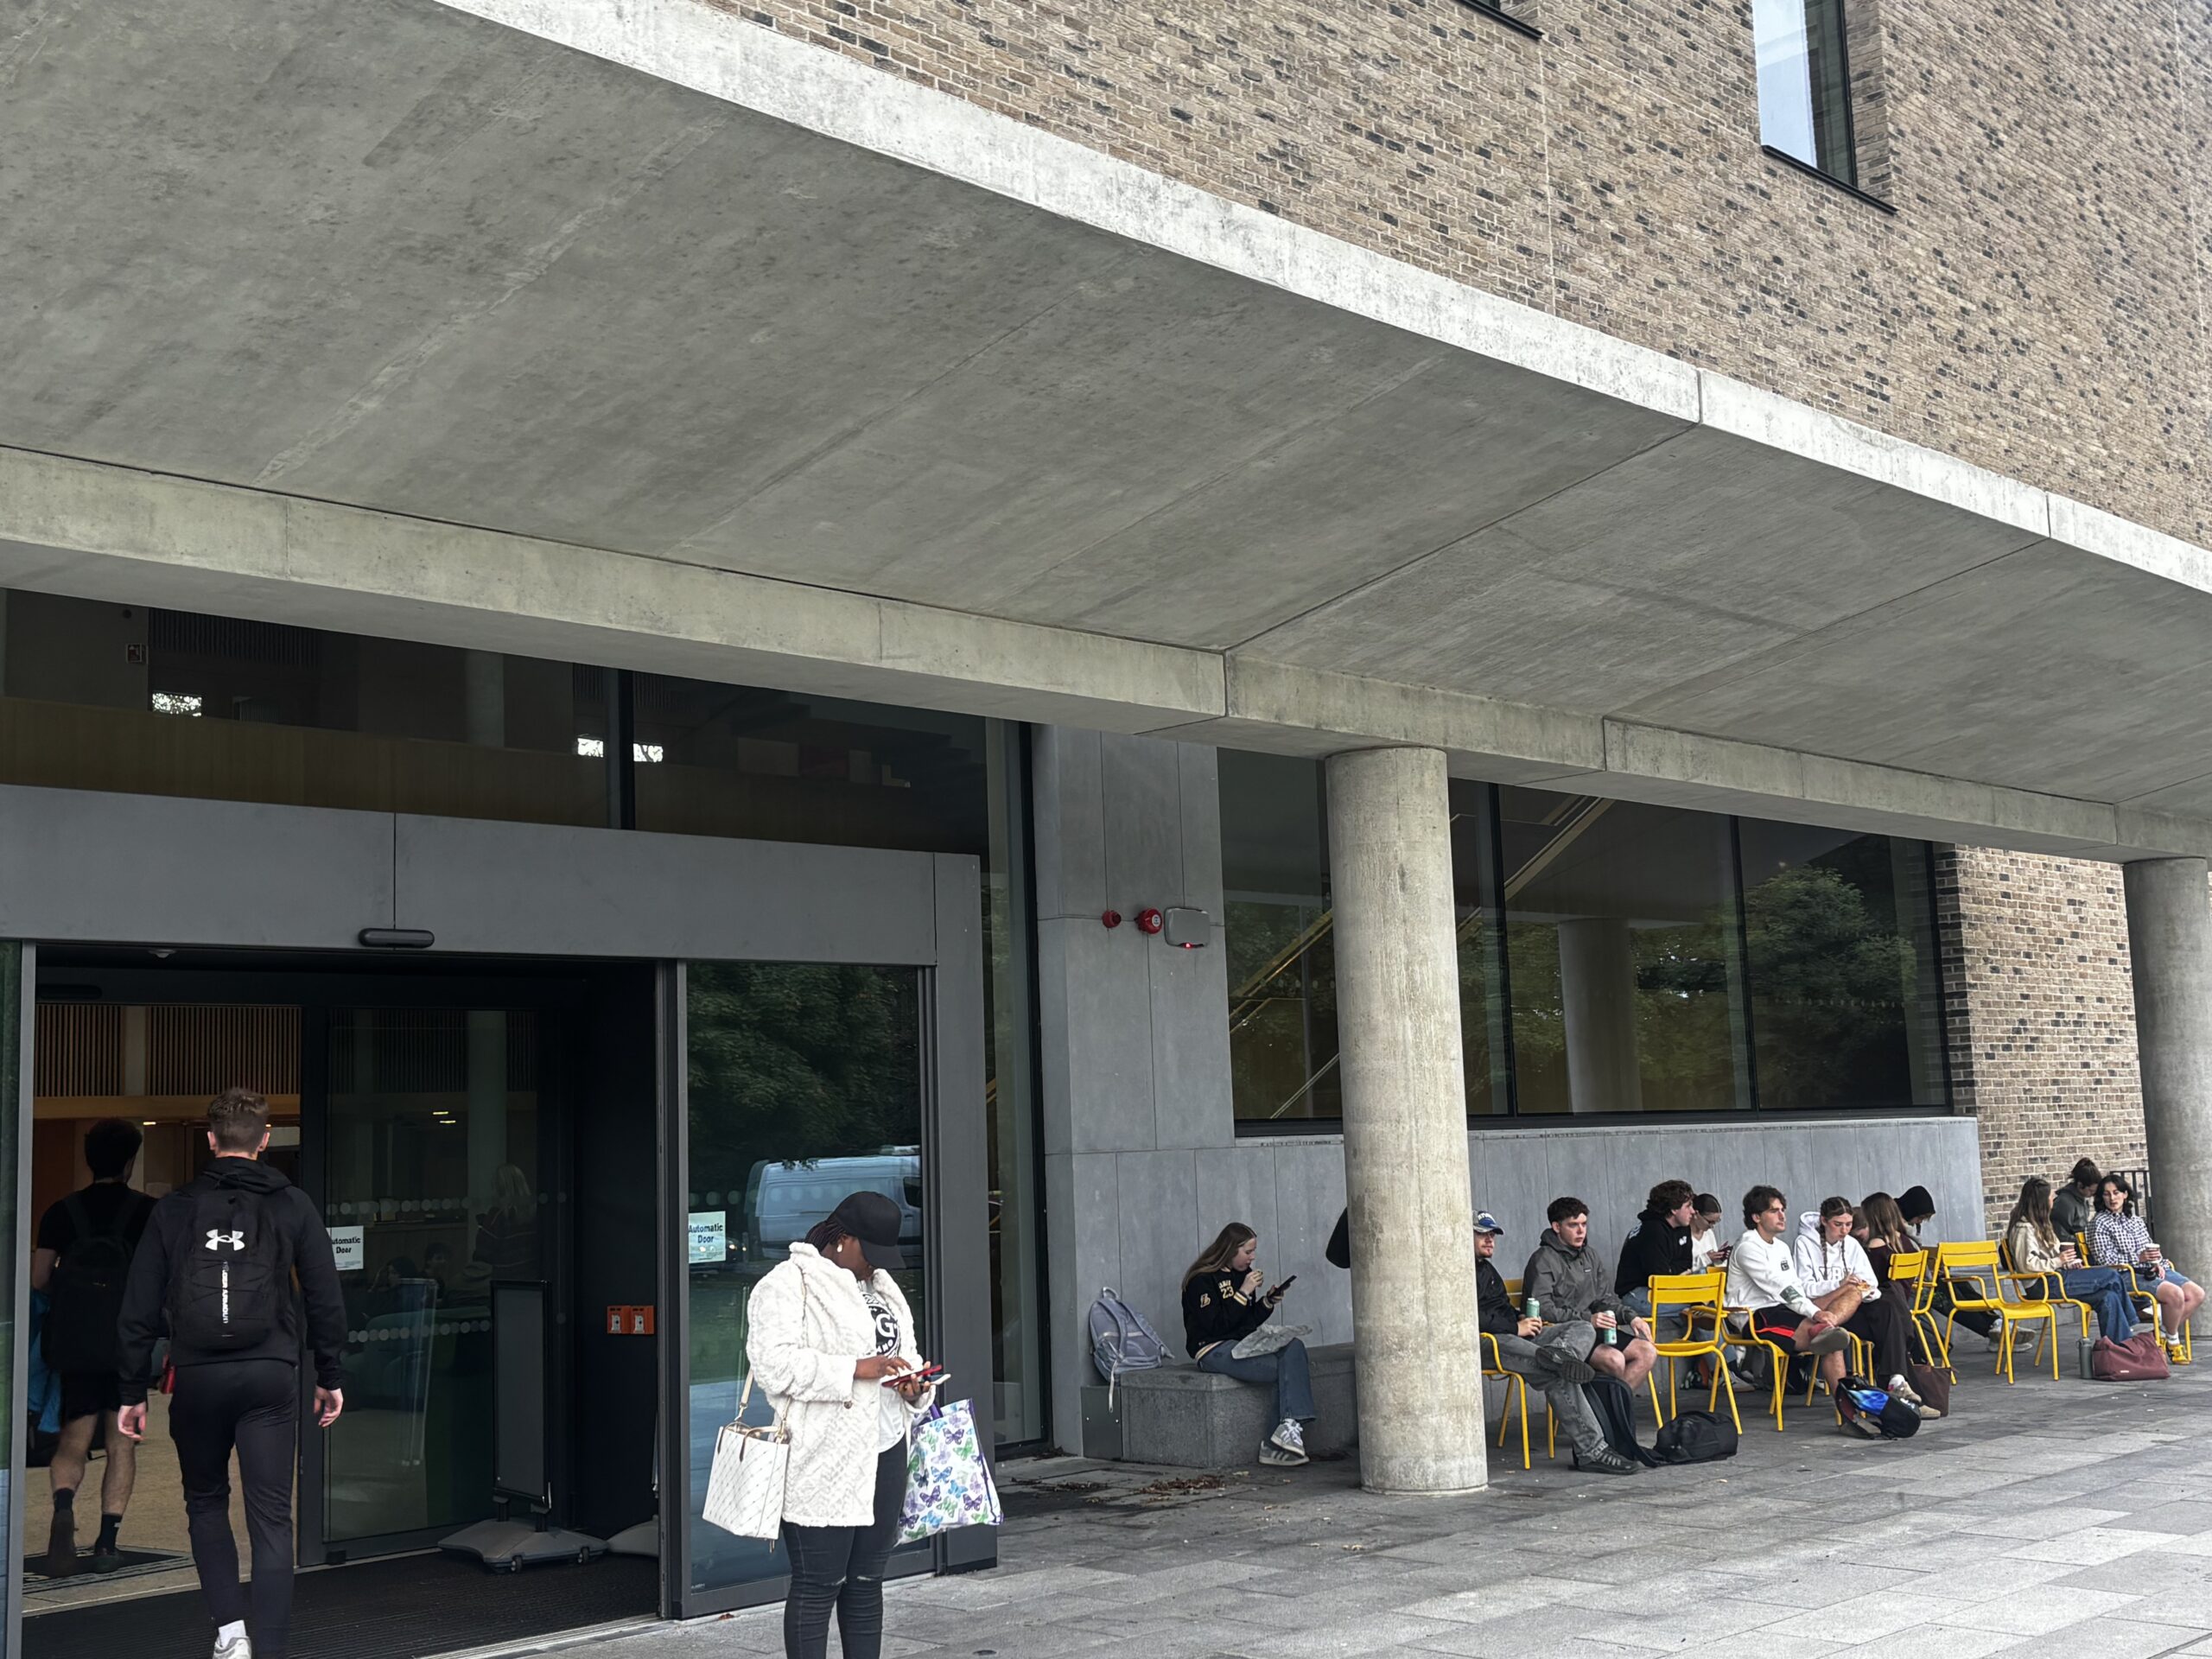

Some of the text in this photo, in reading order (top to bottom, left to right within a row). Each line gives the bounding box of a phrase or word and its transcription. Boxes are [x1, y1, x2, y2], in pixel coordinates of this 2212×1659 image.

[689, 1223, 723, 1233] Automatic
[697, 1235, 715, 1243] Door
[1220, 1286, 1235, 1300] 23
[875, 1313, 896, 1338] G
